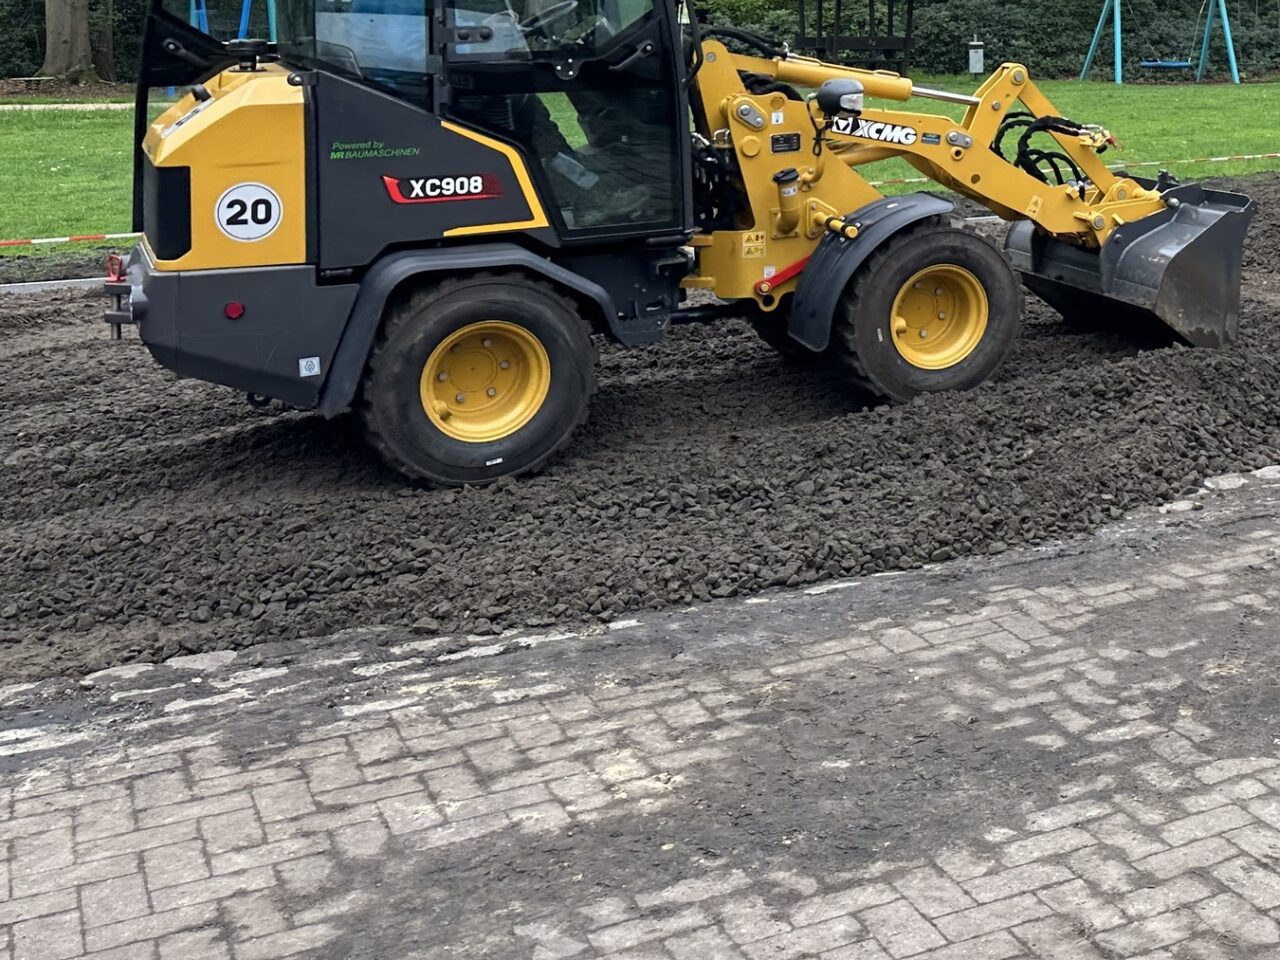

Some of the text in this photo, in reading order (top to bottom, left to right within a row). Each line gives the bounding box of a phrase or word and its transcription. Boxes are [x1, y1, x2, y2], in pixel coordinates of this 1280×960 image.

[851, 119, 918, 145] XCMG
[332, 140, 384, 150] Powered by
[409, 176, 483, 198] XC908
[226, 198, 272, 226] 20
